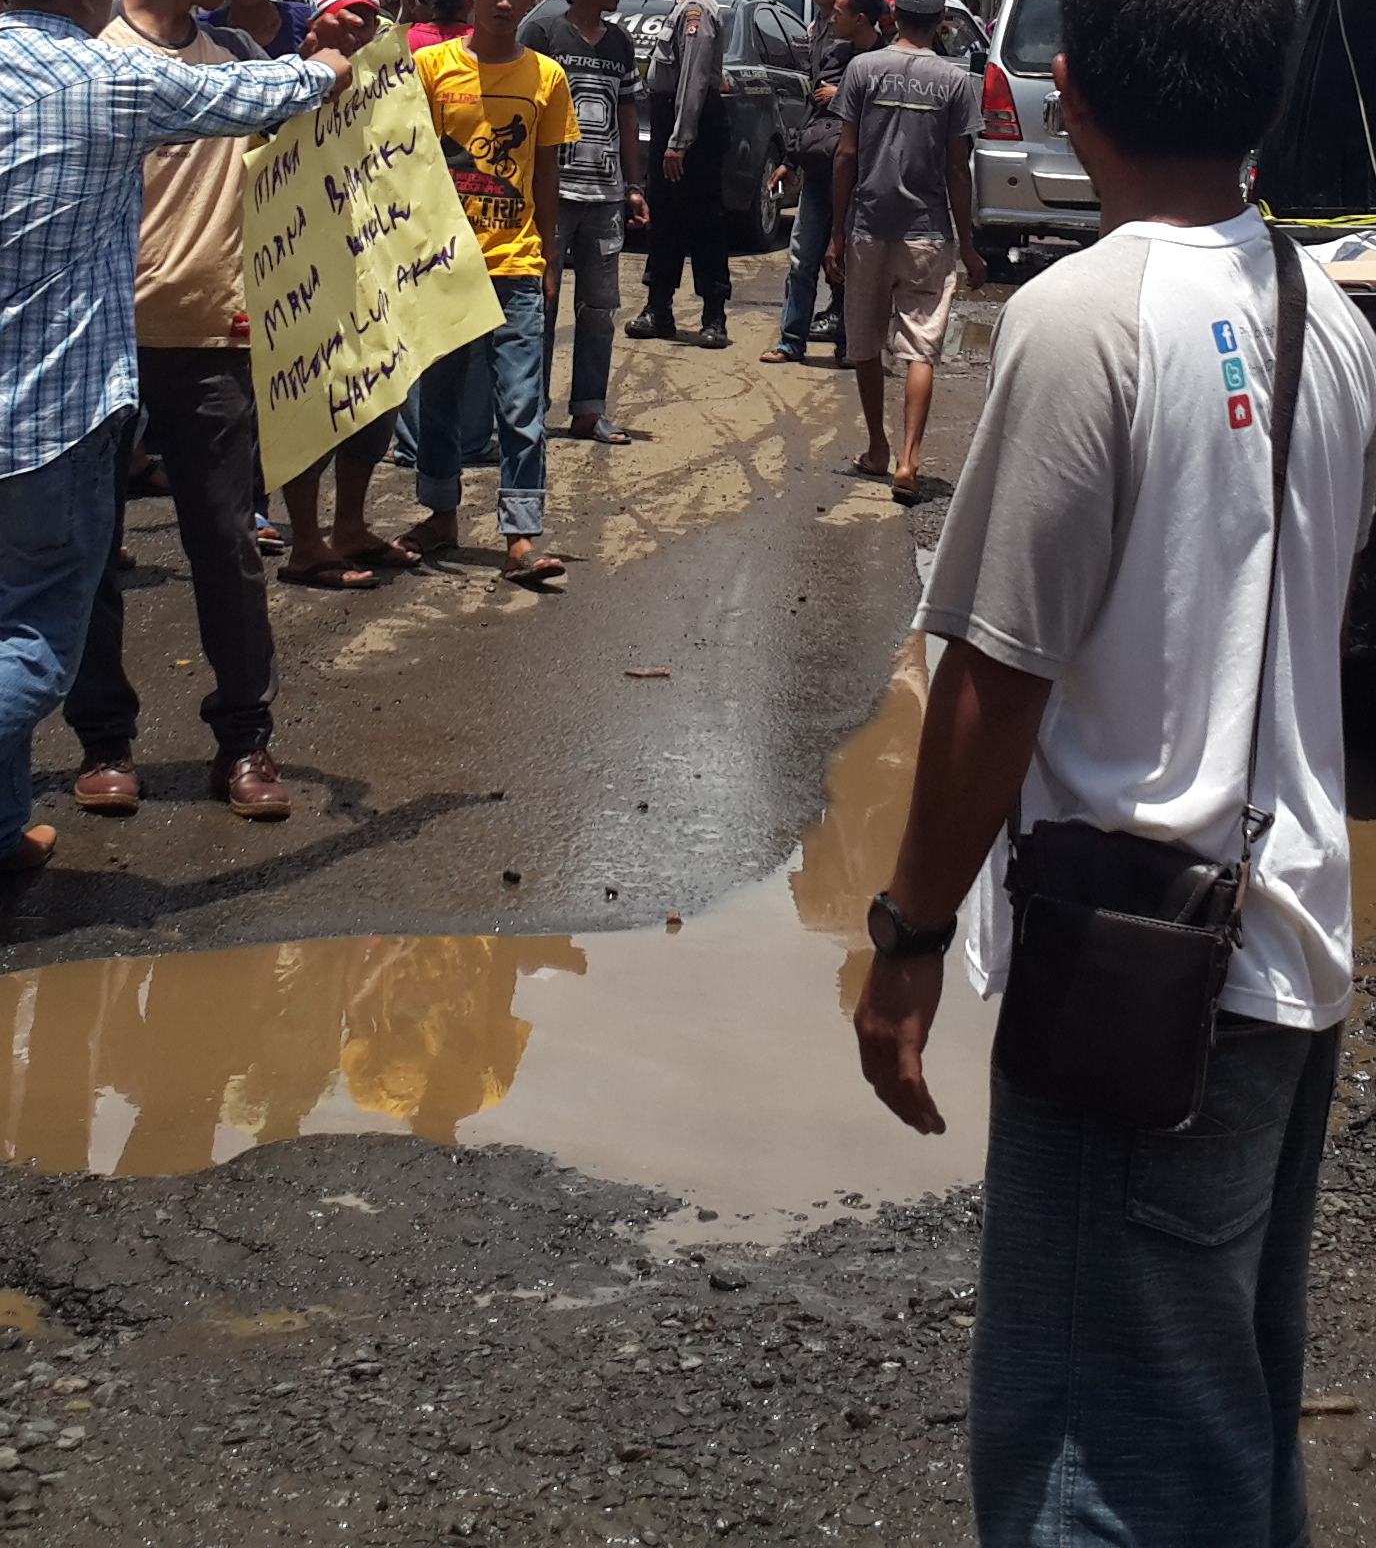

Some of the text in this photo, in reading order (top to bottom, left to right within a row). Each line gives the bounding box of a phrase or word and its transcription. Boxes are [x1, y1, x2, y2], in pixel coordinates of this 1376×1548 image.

[255, 139, 301, 213] MANA
[254, 205, 307, 287] MANA
[264, 265, 321, 351] MANA
